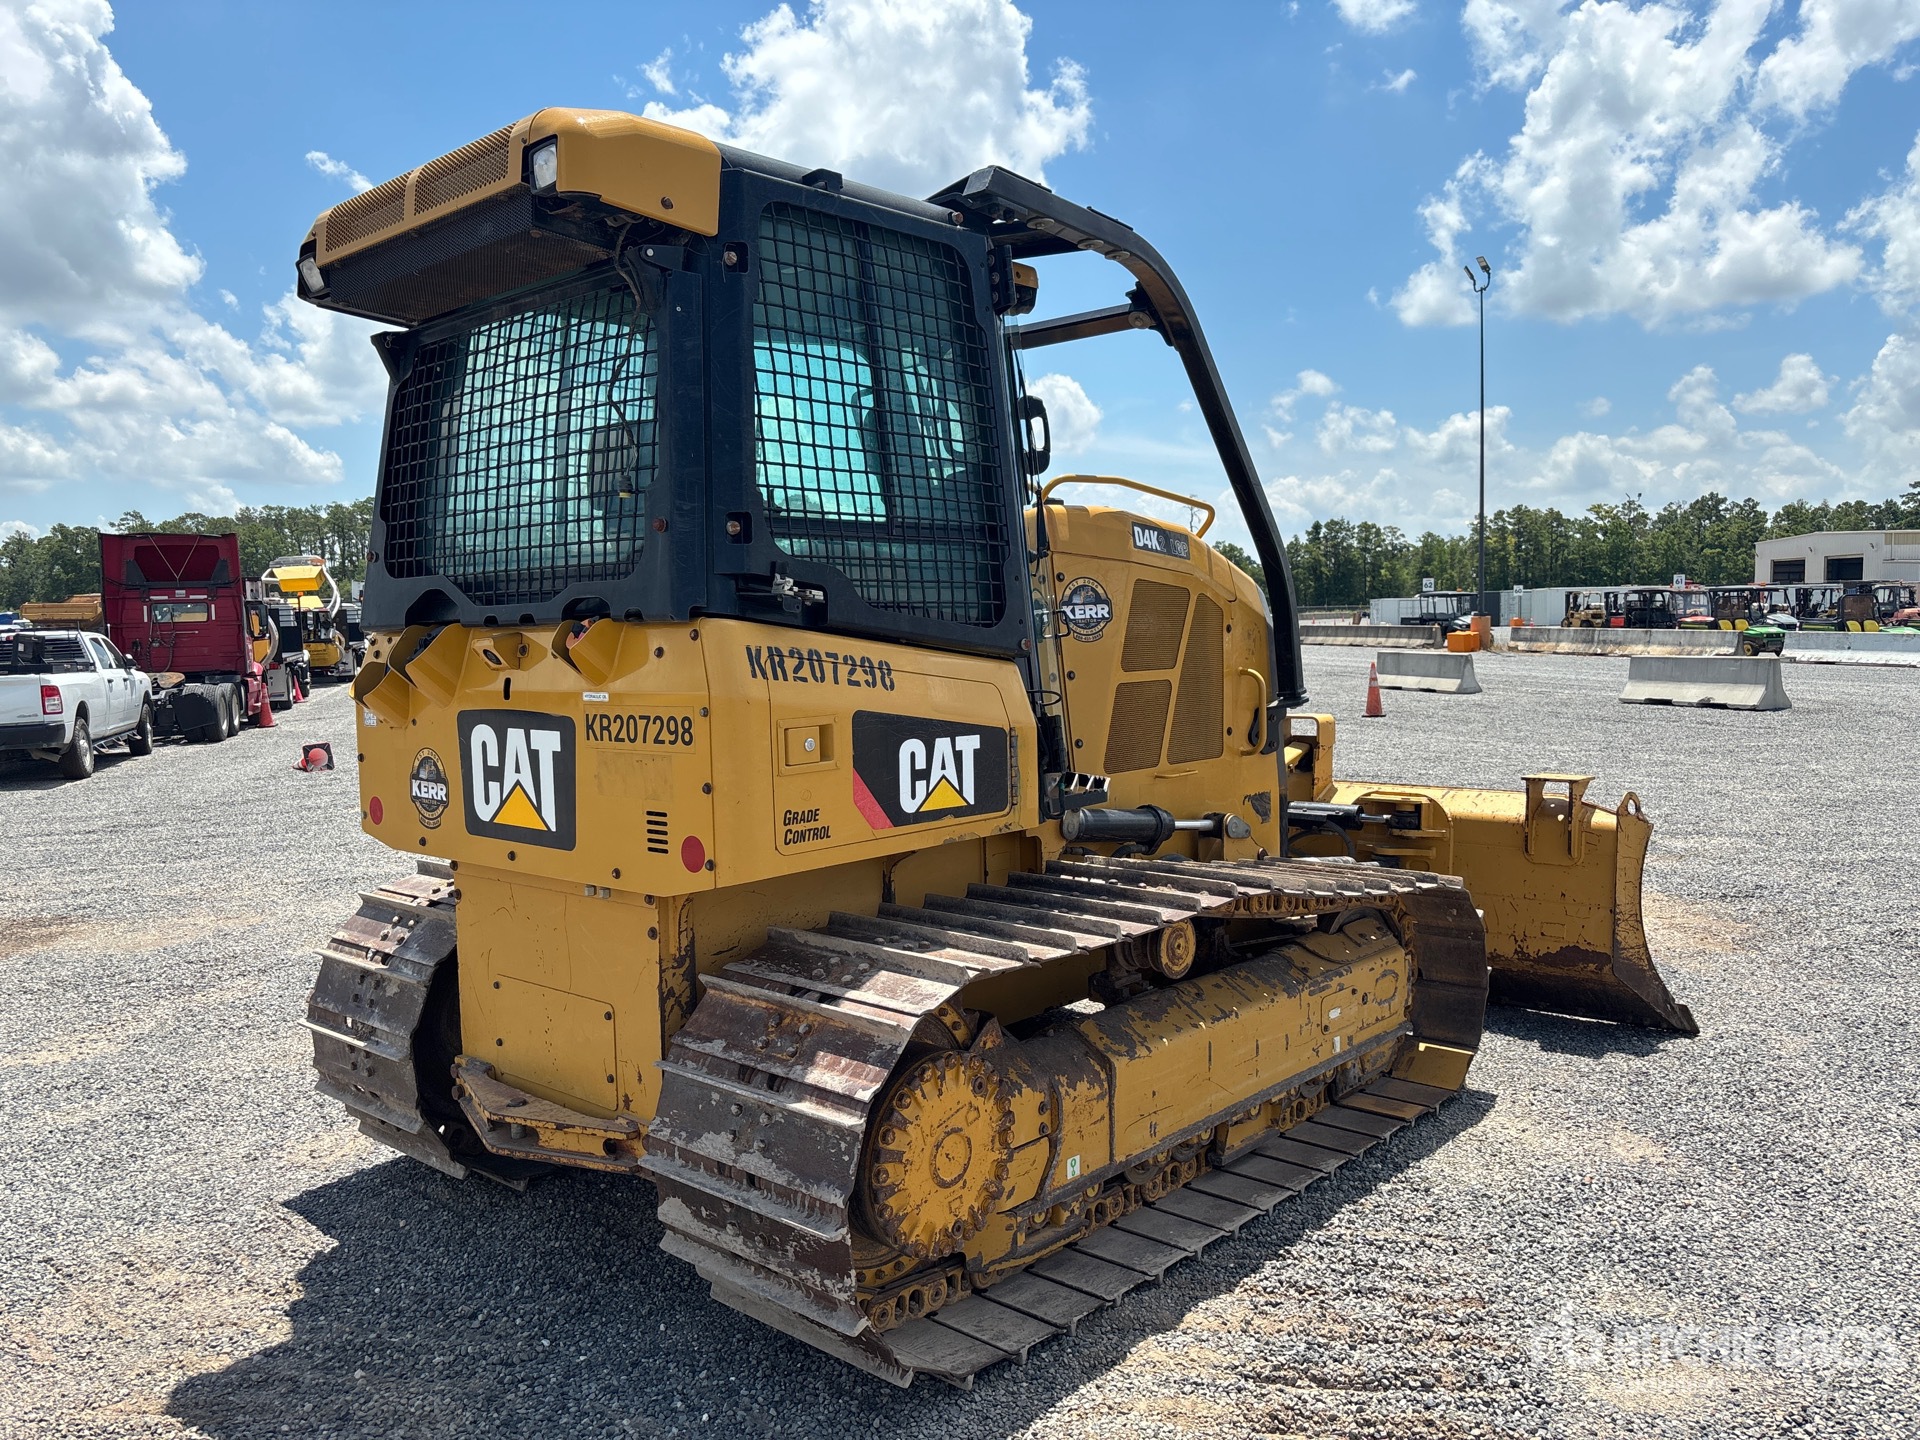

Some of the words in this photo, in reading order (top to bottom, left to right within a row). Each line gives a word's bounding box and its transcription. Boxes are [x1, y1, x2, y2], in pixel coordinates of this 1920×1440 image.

[1068, 580, 1079, 591] EST
[1423, 581, 1433, 589] 62
[1062, 604, 1110, 619] KERR
[745, 644, 895, 692] KR207298
[586, 713, 694, 747] KR207298
[470, 723, 562, 832] CAT
[899, 734, 980, 814] CAT
[411, 779, 447, 801] KERR
[782, 808, 820, 827] GRADE
[783, 825, 832, 846] CONTROL
